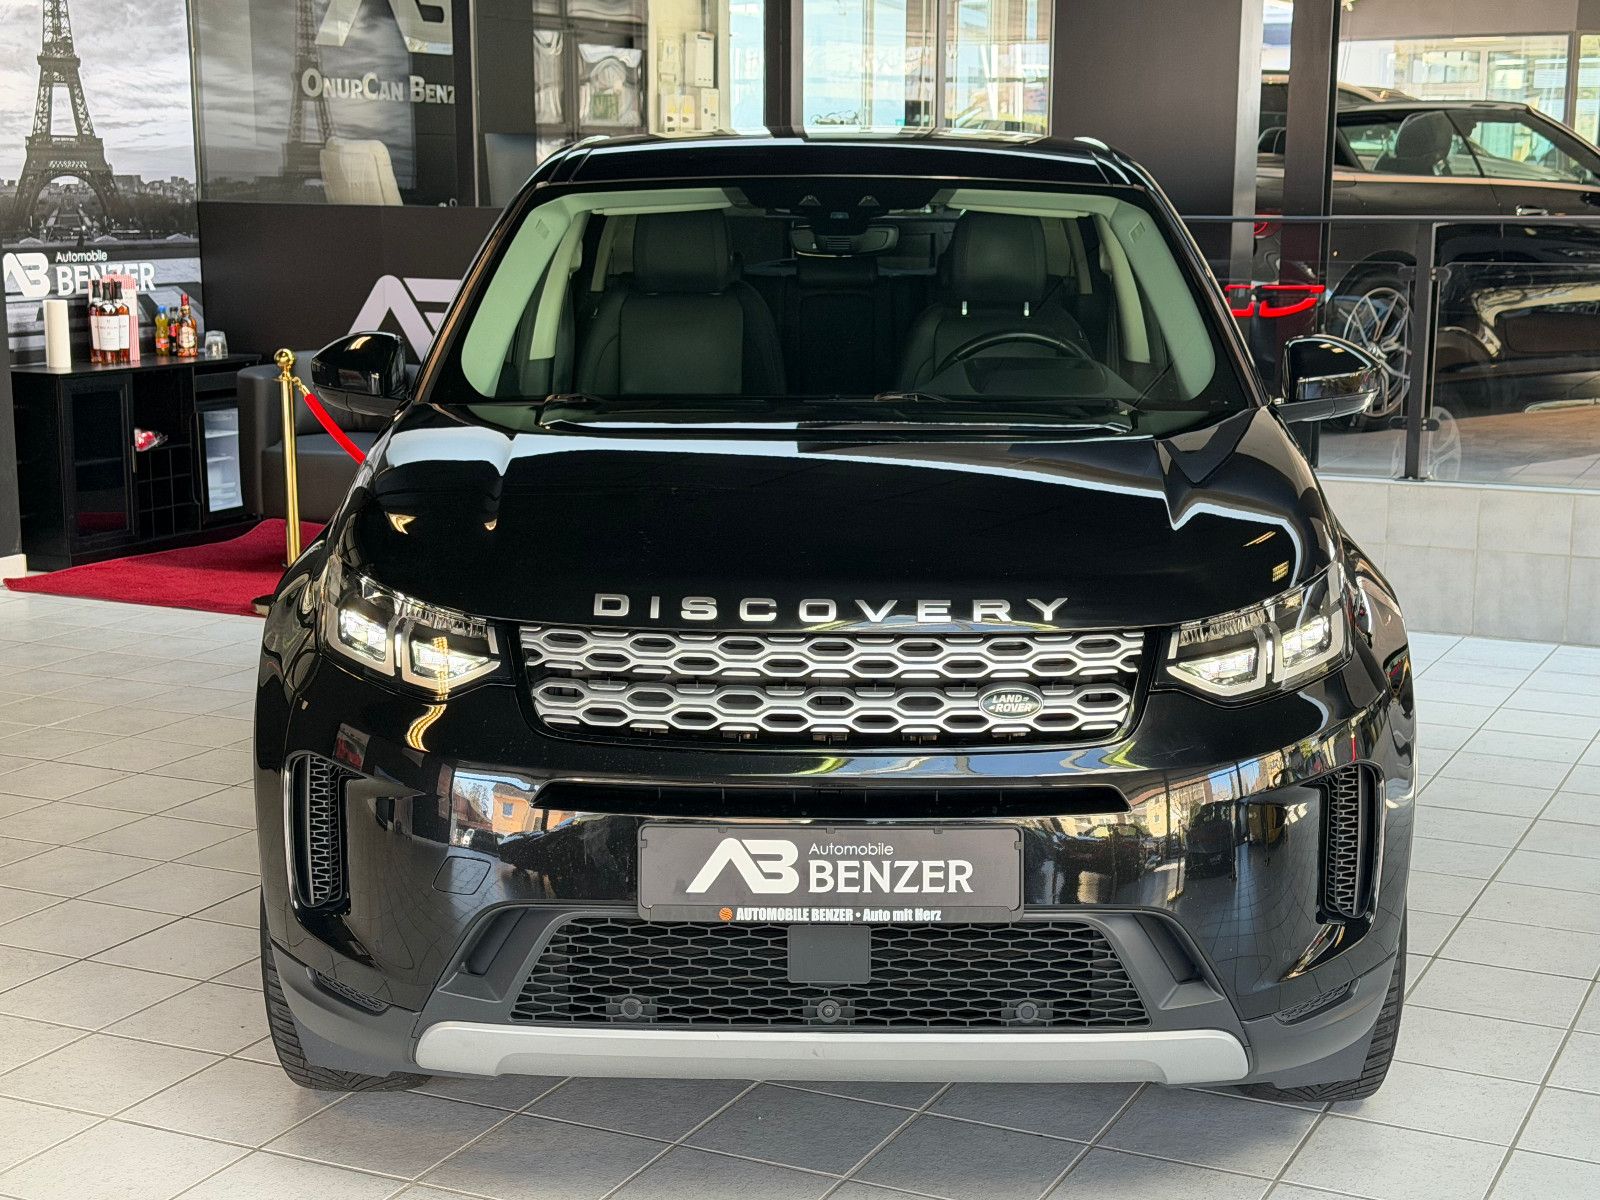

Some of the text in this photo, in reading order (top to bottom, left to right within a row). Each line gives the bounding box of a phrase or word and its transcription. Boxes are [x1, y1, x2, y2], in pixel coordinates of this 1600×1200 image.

[55, 250, 108, 263] Automobile
[593, 593, 1068, 623] DISCOVERY
[993, 694, 1022, 704] LAND
[994, 702, 1033, 713] ROVER
[808, 842, 894, 856] Automobile
[807, 859, 974, 894] BENZER
[735, 907, 942, 922] AUTOMOBILE BENZER Auto mit Herz
